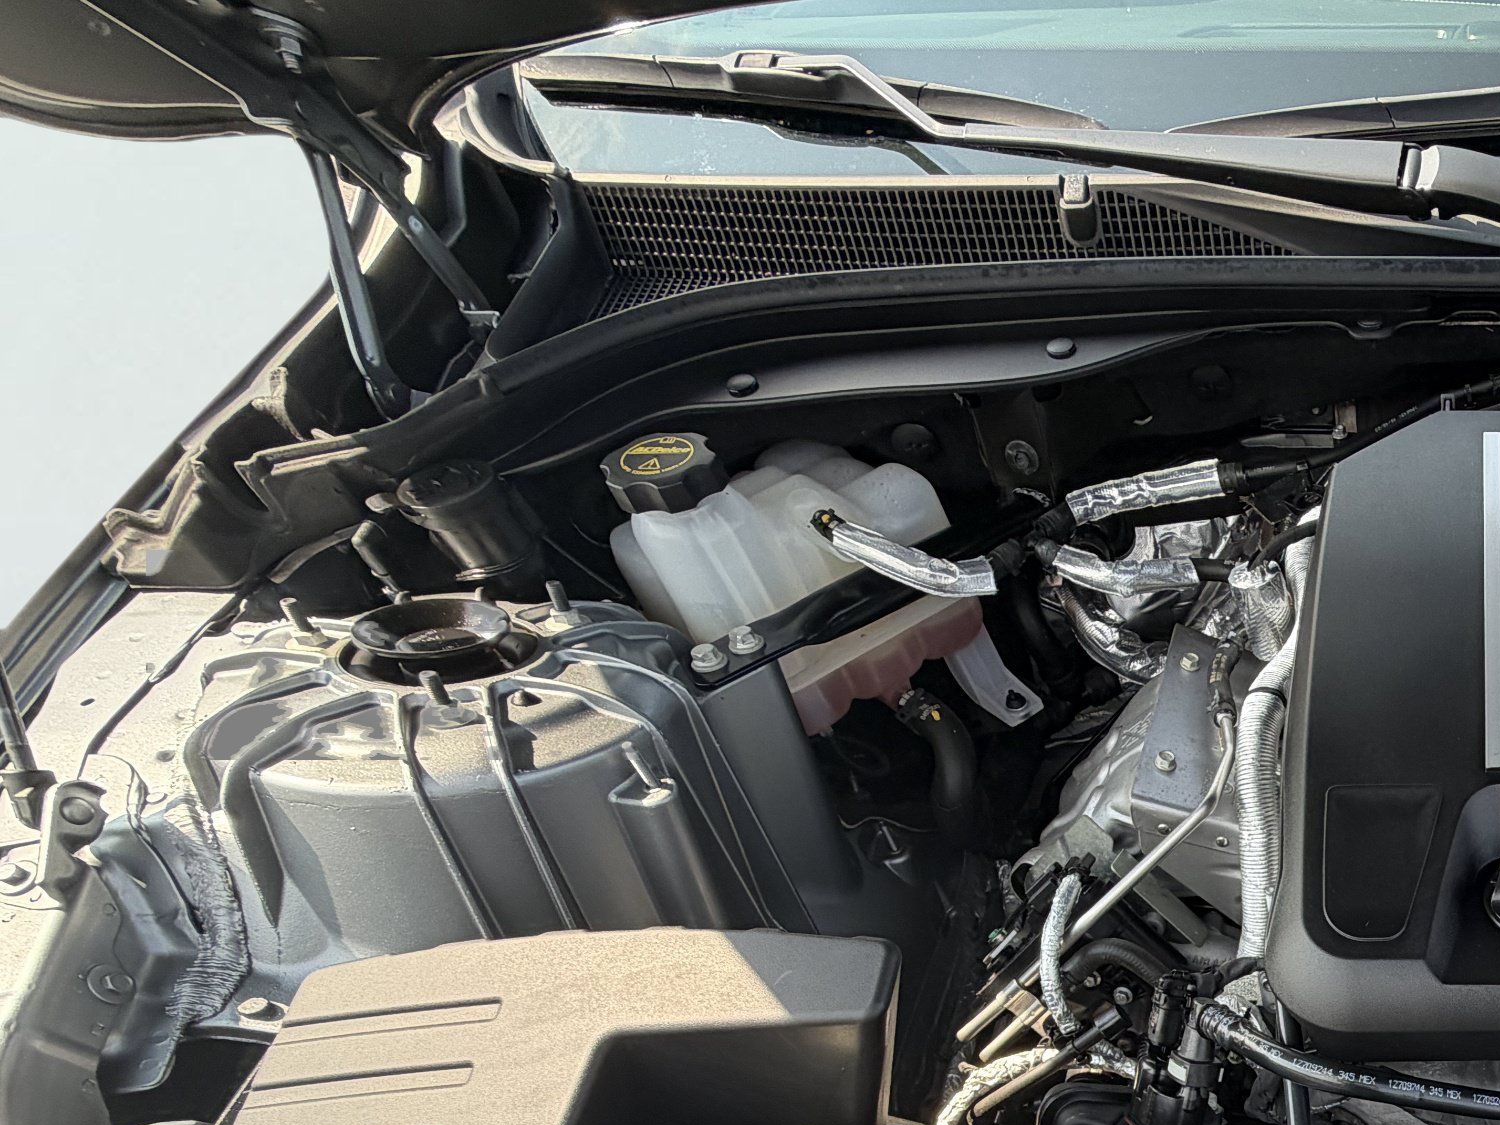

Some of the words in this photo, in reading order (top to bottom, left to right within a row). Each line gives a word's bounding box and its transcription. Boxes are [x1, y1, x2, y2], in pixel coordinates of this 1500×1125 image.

[1337, 1070, 1355, 1081] 345
[1358, 1075, 1376, 1085] MEX
[1429, 1086, 1443, 1097] 345
[1446, 1090, 1461, 1100] MEX
